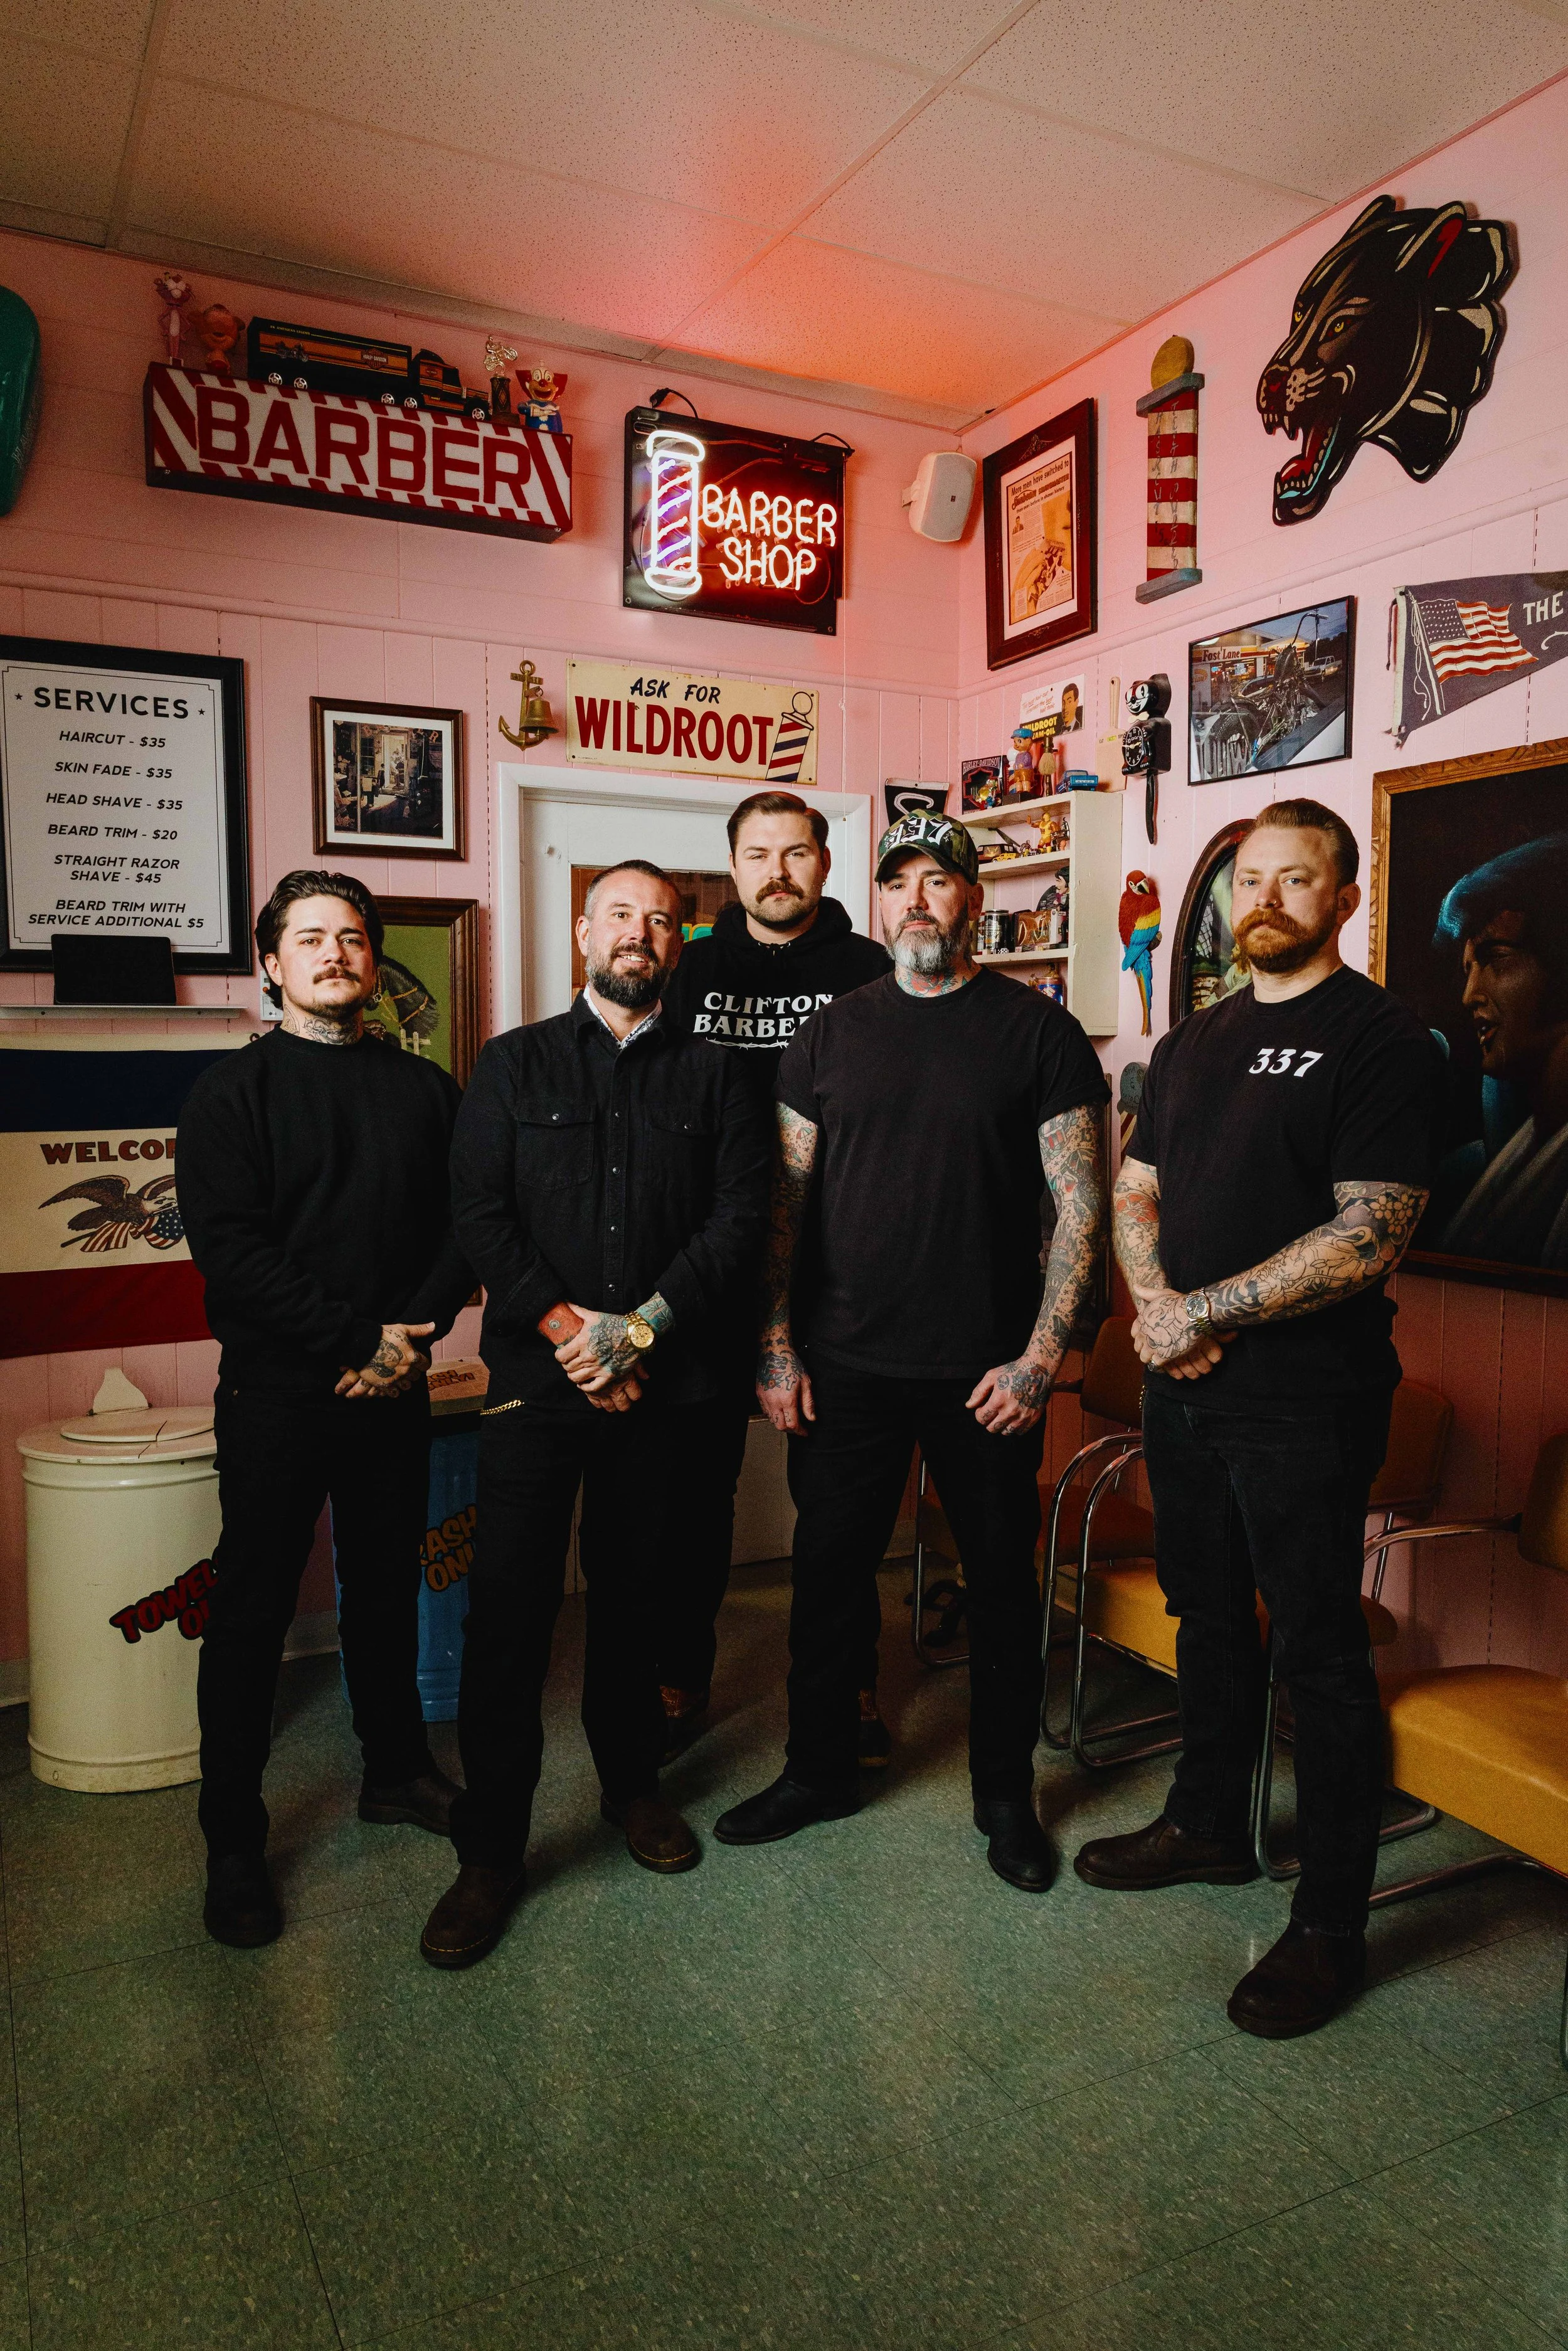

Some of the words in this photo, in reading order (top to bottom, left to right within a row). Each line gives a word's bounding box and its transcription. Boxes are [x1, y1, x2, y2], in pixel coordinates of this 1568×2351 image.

[197, 385, 531, 509] BARBER
[1011, 486, 1022, 496] More
[1022, 480, 1032, 490] men
[1033, 474, 1043, 485] have
[1044, 460, 1063, 479] switched
[702, 484, 837, 547] BARBER
[719, 536, 817, 591] SHOP
[1523, 591, 1564, 625] THE
[1202, 649, 1220, 662] Fast
[1222, 647, 1240, 659] Lane
[34, 687, 189, 719] SERVICES
[630, 677, 670, 699] ASK
[684, 684, 721, 704] FOR
[59, 730, 125, 745] HAIRCUT
[139, 736, 166, 748] $35
[575, 696, 774, 765] WILDROOT
[55, 762, 88, 773] SKIN
[93, 764, 132, 777] FADE
[146, 767, 172, 779] $35
[963, 757, 1000, 775] HARLEY-DAVIDSON
[46, 793, 88, 805] HEAD
[92, 795, 142, 808] SHAVE
[157, 799, 183, 810] $35
[48, 824, 98, 836] BEARD
[104, 827, 138, 839] TRIM
[152, 829, 177, 840] $20
[886, 815, 953, 849] 337
[54, 854, 127, 867] STRAIGHT
[130, 857, 180, 869] RAZOR
[70, 870, 121, 882] SHAVE
[135, 873, 162, 883] $45
[56, 900, 106, 911] BEARD
[112, 901, 145, 912] TRIM
[150, 902, 186, 913] WITH
[28, 914, 91, 926] SERVICE
[95, 916, 182, 928] ADDITIONAL
[187, 918, 204, 928] $5
[704, 992, 834, 1014] CLIFTON
[693, 1014, 810, 1038] BARBE
[1248, 1048, 1324, 1077] 337
[419, 1504, 477, 1566] ASH
[110, 1557, 219, 1643] TOWEL
